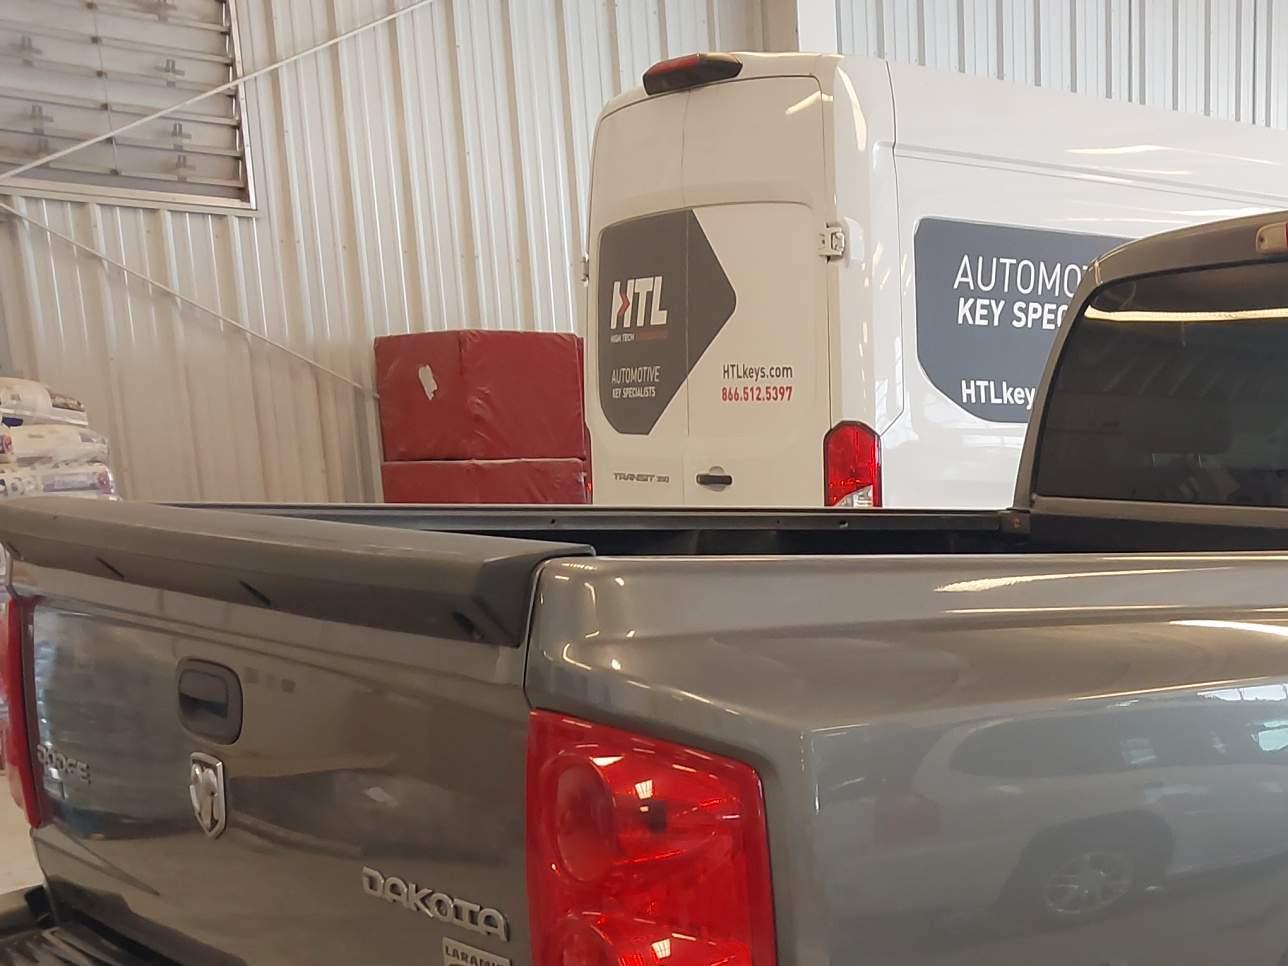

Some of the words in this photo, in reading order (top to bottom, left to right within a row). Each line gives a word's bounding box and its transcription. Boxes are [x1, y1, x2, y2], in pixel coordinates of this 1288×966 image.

[953, 254, 1089, 298] AUTOMO
[610, 276, 668, 330] HTL
[957, 297, 1005, 326] KEY
[611, 365, 661, 384] AUTOMOTIVE
[722, 363, 793, 382] HTLkeys.com
[612, 387, 621, 399] KEY
[622, 386, 656, 398] SPECIALISTS
[721, 385, 793, 402] 866.512.5397
[961, 379, 1036, 410] HTLkey
[362, 866, 510, 942] DAKOTA
